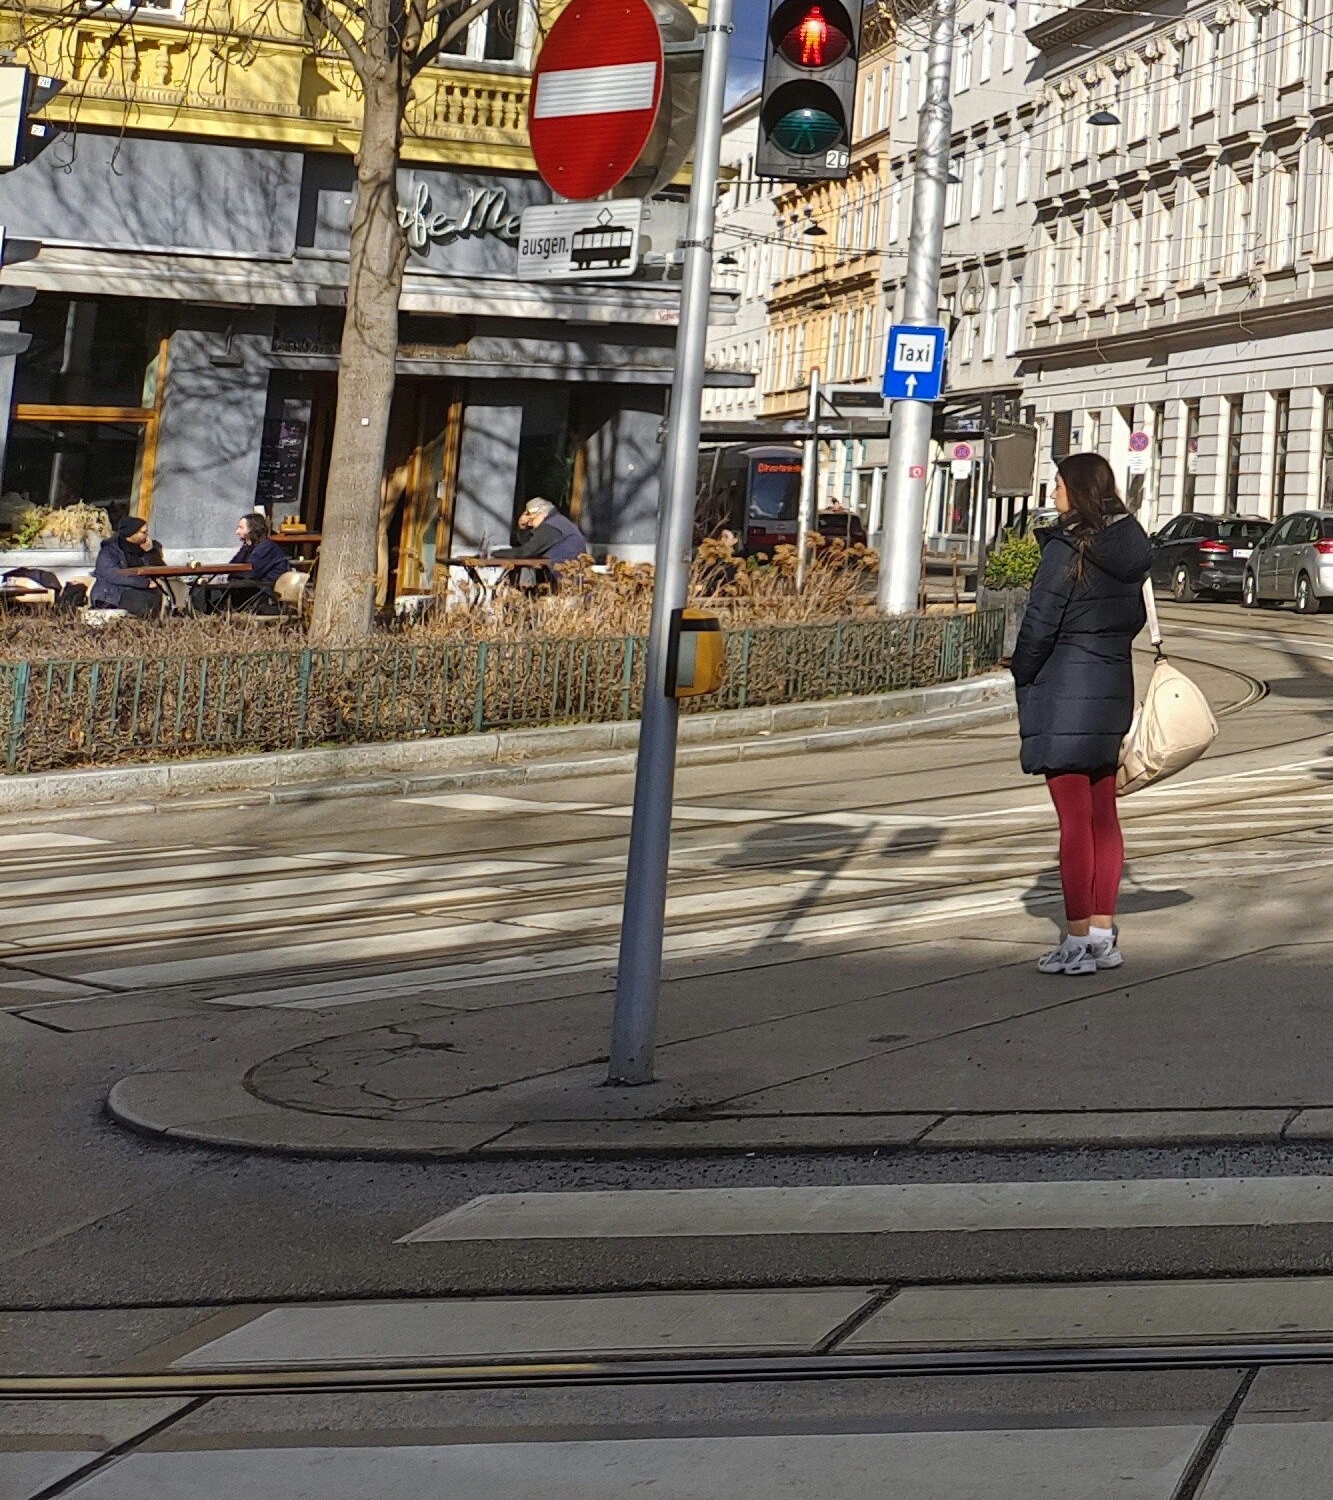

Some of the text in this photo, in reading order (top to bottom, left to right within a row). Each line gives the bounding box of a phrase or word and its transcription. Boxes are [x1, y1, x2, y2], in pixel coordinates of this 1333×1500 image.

[827, 152, 848, 167] 20
[397, 182, 456, 248] fe
[522, 237, 569, 259] ausgen.
[899, 343, 931, 362] Taxi
